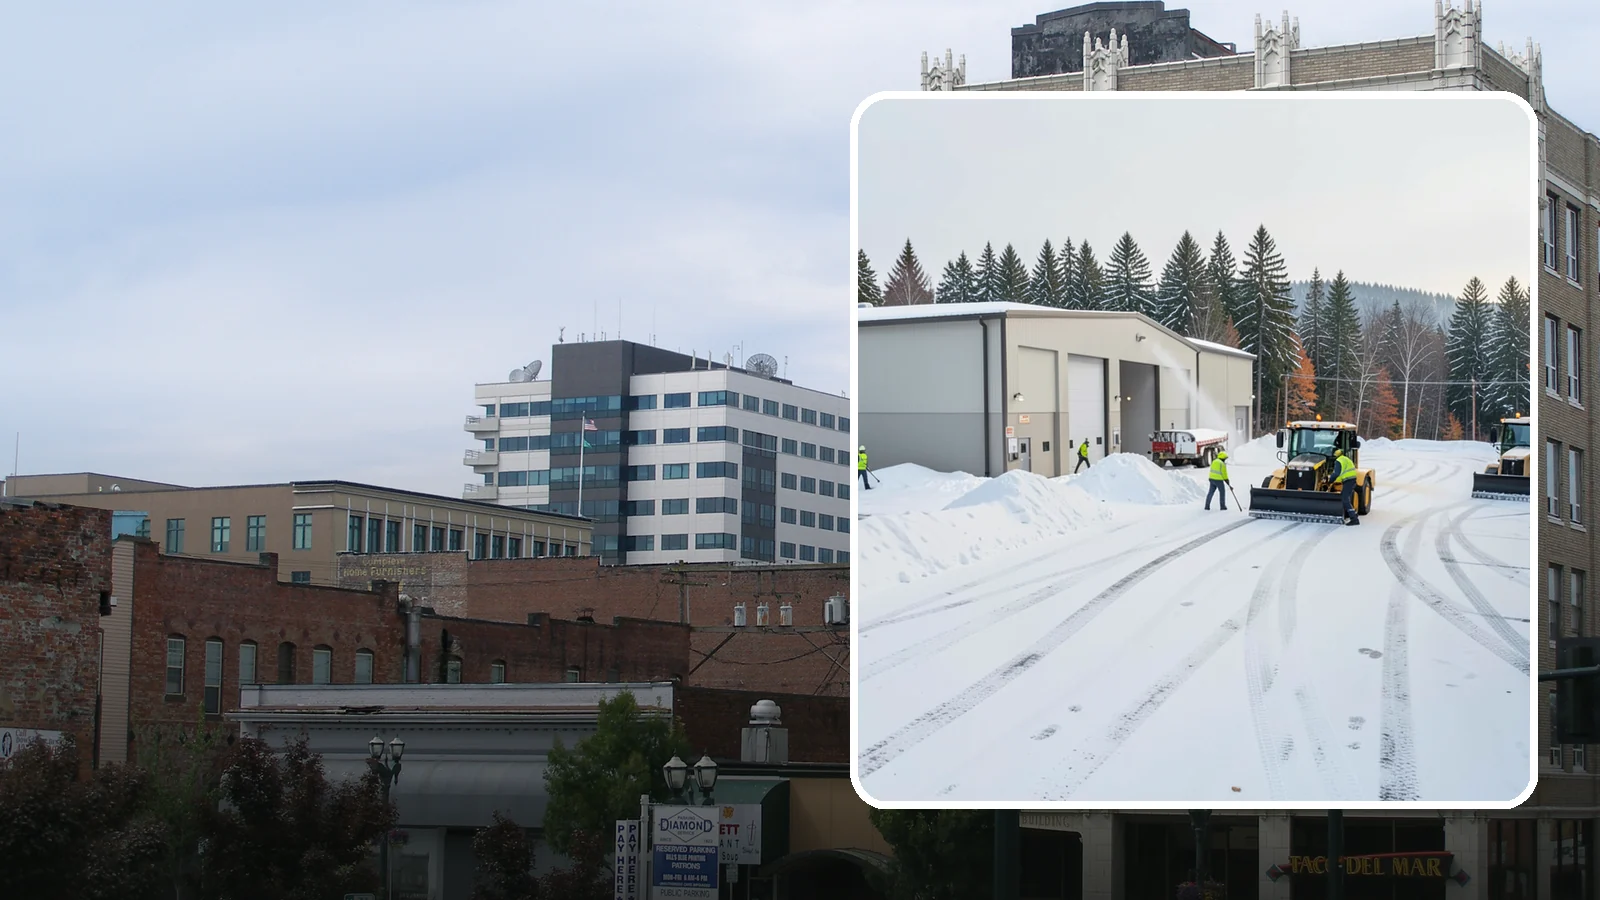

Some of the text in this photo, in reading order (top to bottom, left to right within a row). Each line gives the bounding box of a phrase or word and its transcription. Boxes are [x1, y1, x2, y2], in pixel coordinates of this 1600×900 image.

[343, 566, 427, 577] Home Furnishers
[660, 818, 713, 833] DIAMOND
[1022, 815, 1070, 828] BUILDING
[719, 824, 740, 835] ETT
[655, 845, 716, 854] RESERVED PARKING
[719, 839, 740, 849] ANT
[616, 825, 625, 894] PAY HERE
[627, 824, 637, 893] PAY HERE
[721, 851, 739, 862] Soup
[671, 862, 701, 870] PATRONS
[1346, 857, 1385, 876] DEL
[1391, 857, 1442, 877] MAR
[660, 888, 710, 899] PUBLIC PARKING
